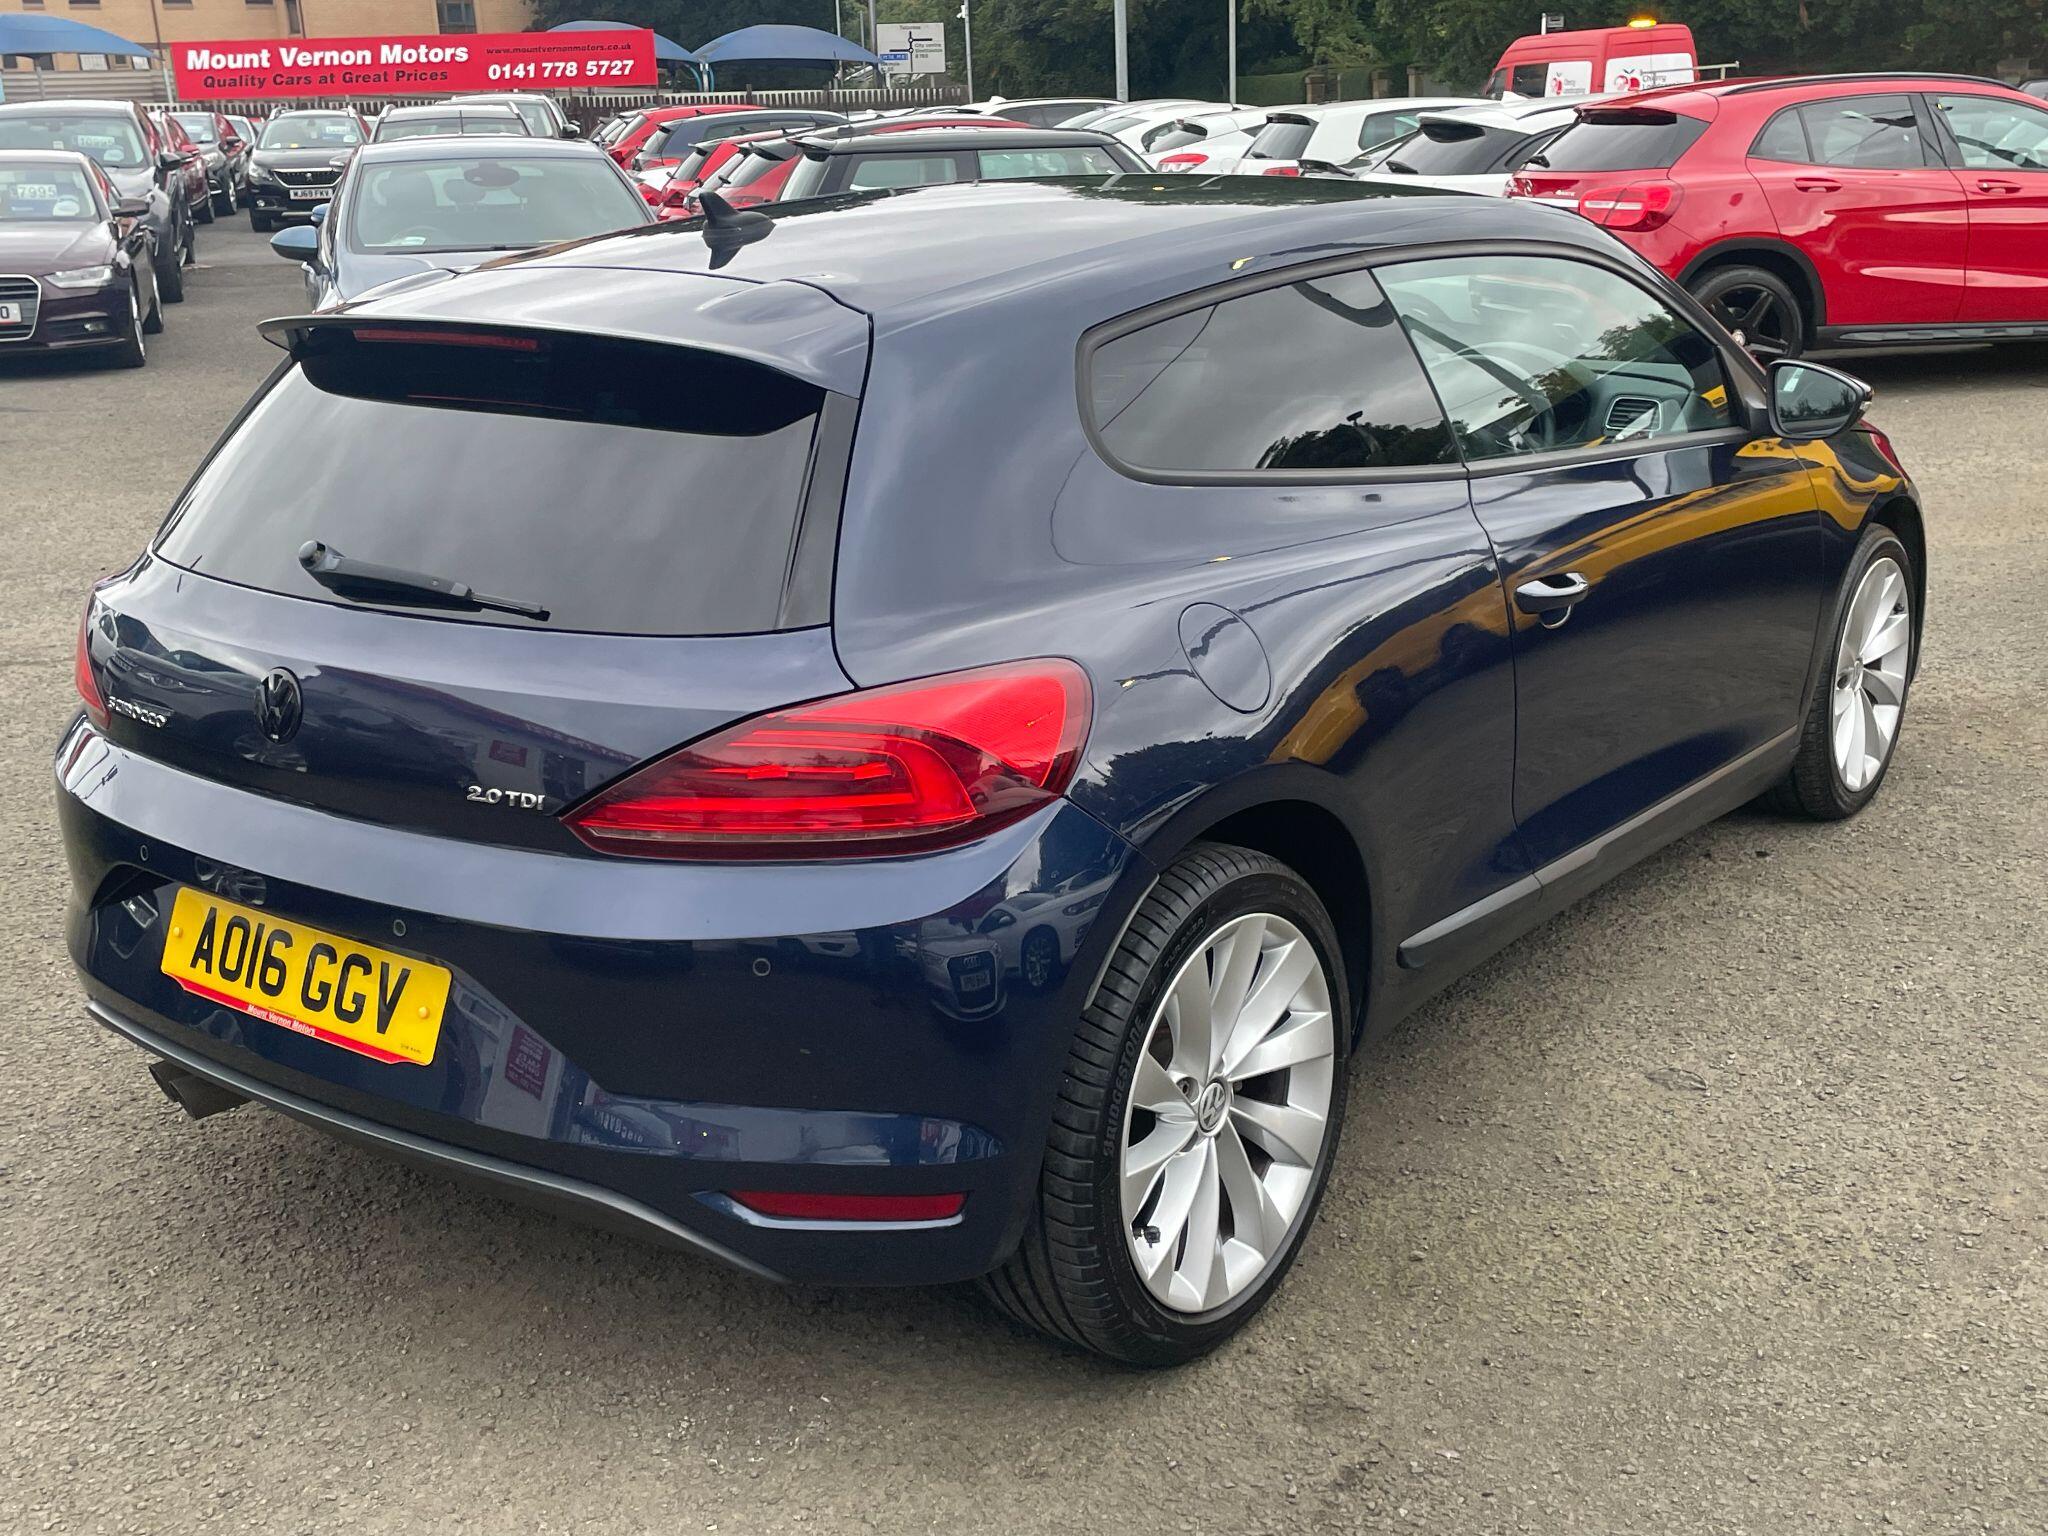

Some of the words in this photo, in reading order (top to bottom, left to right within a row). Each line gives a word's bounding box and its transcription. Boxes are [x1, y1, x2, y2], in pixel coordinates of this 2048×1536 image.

[187, 49, 271, 70] Mount
[279, 47, 372, 67] Vernon
[380, 44, 469, 65] Motors
[486, 43, 631, 54] www.mountvernonmotors.co.uk
[203, 74, 266, 91] Quality
[272, 73, 312, 86] Cars
[318, 72, 335, 85] at
[342, 70, 388, 84] Great
[395, 69, 448, 82] Prices
[488, 62, 535, 80] 0141
[541, 61, 578, 78] 778
[585, 59, 635, 76] 5727
[505, 790, 546, 811] TDI
[190, 906, 293, 997] AO16
[301, 942, 411, 1035] GGV
[247, 1004, 268, 1019] Mount
[268, 1011, 292, 1027] Vernon
[291, 1019, 316, 1036] Motors
[1104, 1015, 1145, 1157] BRIDGESTONE
